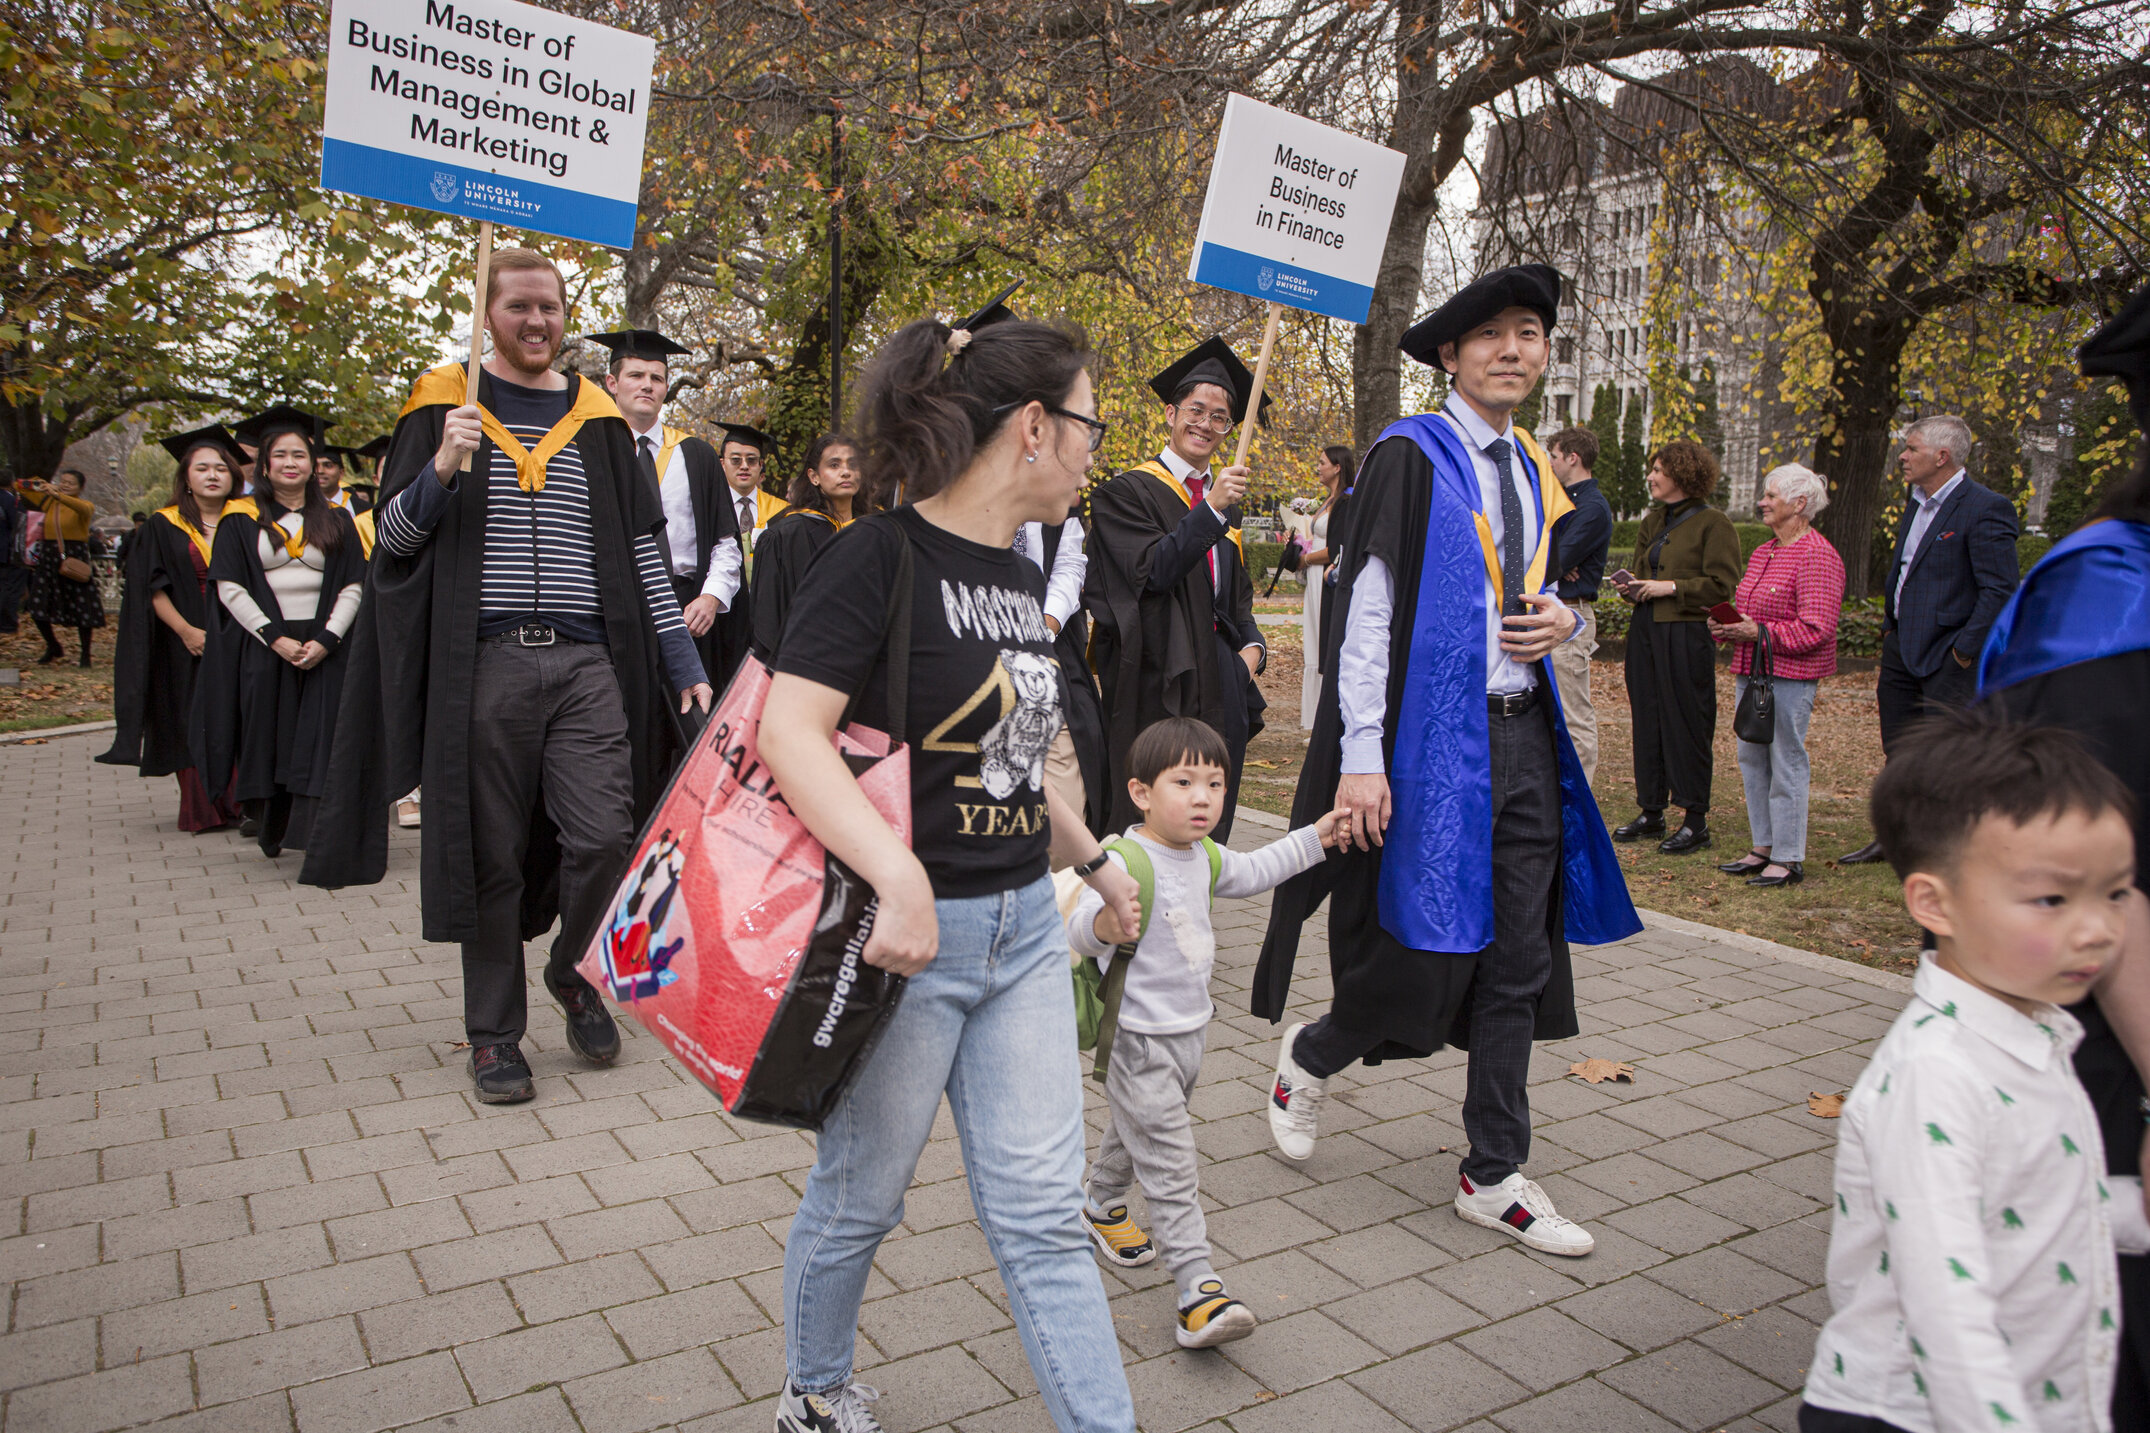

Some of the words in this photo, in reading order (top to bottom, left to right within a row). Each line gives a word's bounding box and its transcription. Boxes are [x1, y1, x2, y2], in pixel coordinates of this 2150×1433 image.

[426, 0, 536, 51] Master
[543, 35, 576, 61] of
[348, 18, 494, 79] Business
[502, 57, 529, 89] in
[538, 68, 636, 115] Global
[370, 64, 581, 139] Management
[588, 119, 610, 146] &
[410, 113, 568, 178] Marketing
[1274, 143, 1336, 183] Master
[1338, 168, 1358, 190] of
[464, 189, 541, 213] UNIVERSITY
[465, 180, 519, 199] LINCOLN
[1270, 176, 1346, 219] Business
[1256, 204, 1273, 230] in
[1277, 211, 1345, 250] Finance
[1275, 280, 1319, 297] UNIVERSITY
[1277, 272, 1308, 287] LINCOLN
[713, 779, 778, 829] HIRE
[813, 892, 880, 1048] gwcregaliahir
